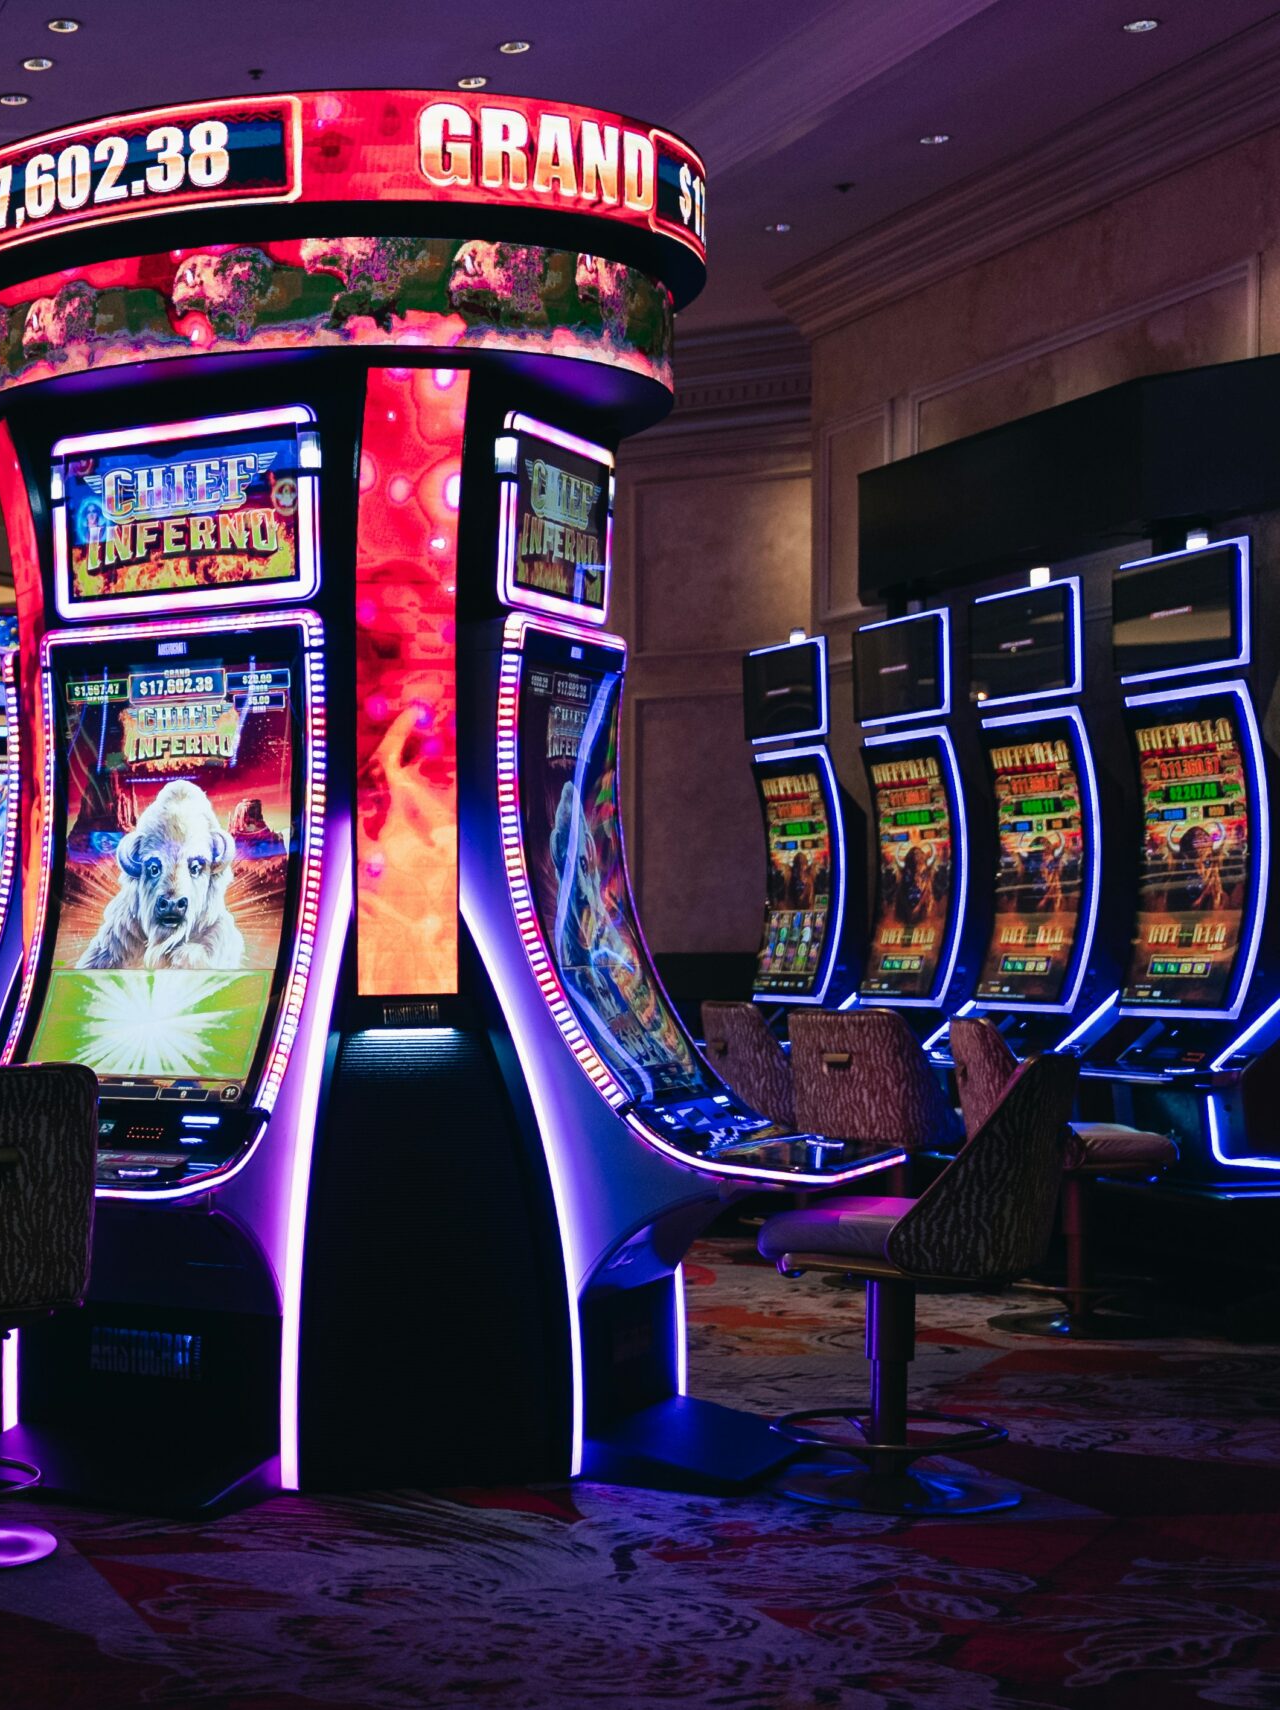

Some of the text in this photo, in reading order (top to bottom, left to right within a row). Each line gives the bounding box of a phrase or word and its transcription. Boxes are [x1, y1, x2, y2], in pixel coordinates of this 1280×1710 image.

[419, 103, 655, 211] GRAND
[103, 453, 258, 523] CHIEF
[531, 459, 595, 530] CHIEF
[87, 508, 277, 570] INFERNO
[521, 512, 598, 577] INFERNO
[140, 676, 214, 696] $17,602.38
[127, 734, 235, 762] INFERNO
[137, 704, 222, 735] CHIEF
[547, 735, 578, 758] INFER
